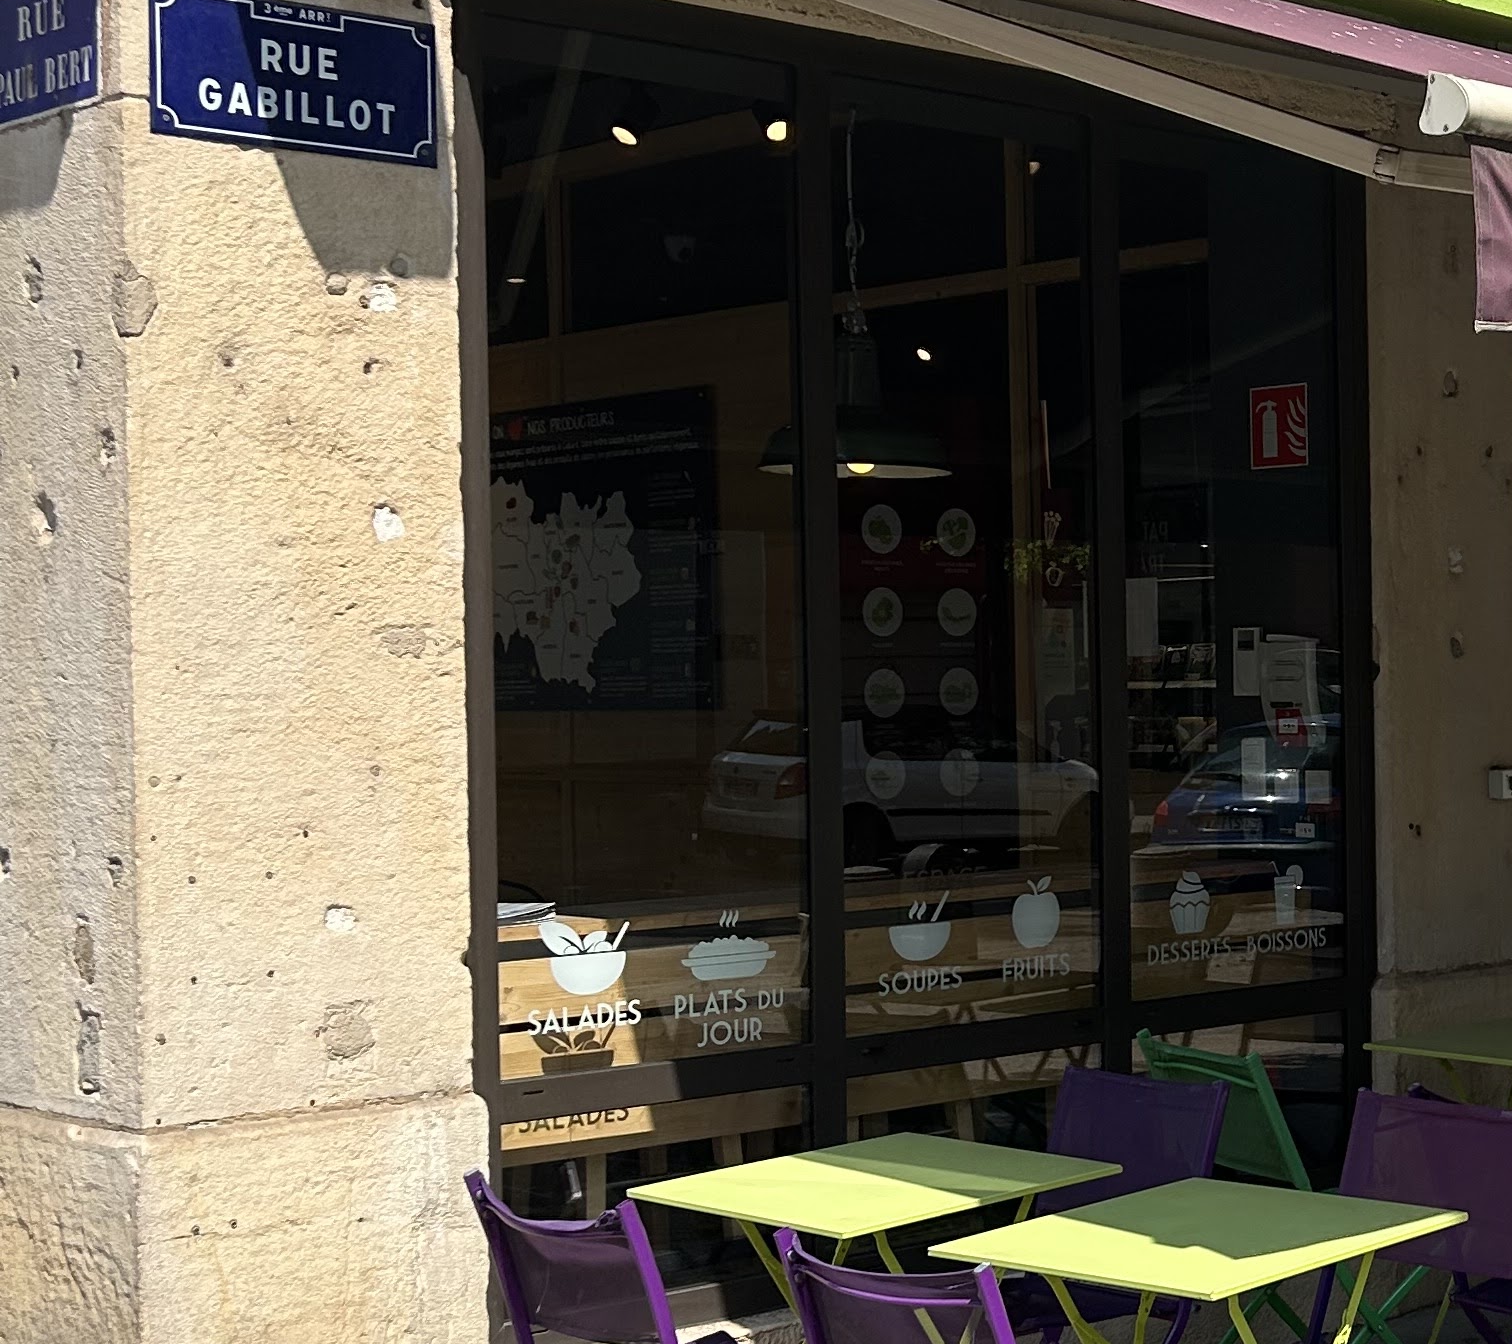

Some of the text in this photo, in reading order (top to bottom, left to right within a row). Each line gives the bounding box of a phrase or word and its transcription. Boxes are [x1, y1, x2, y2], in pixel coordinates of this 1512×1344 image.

[45, 44, 93, 94] BERT
[260, 38, 339, 82] RUE
[199, 77, 396, 135] GABILLOT
[1147, 936, 1232, 966] DESSERTS
[1246, 927, 1327, 954] BOISSONS
[877, 965, 963, 997] SOUPES
[1002, 953, 1071, 984] FRUITS
[527, 999, 642, 1037] SALADES
[674, 987, 785, 1019] PLATS DU
[697, 1017, 763, 1048] JOUR
